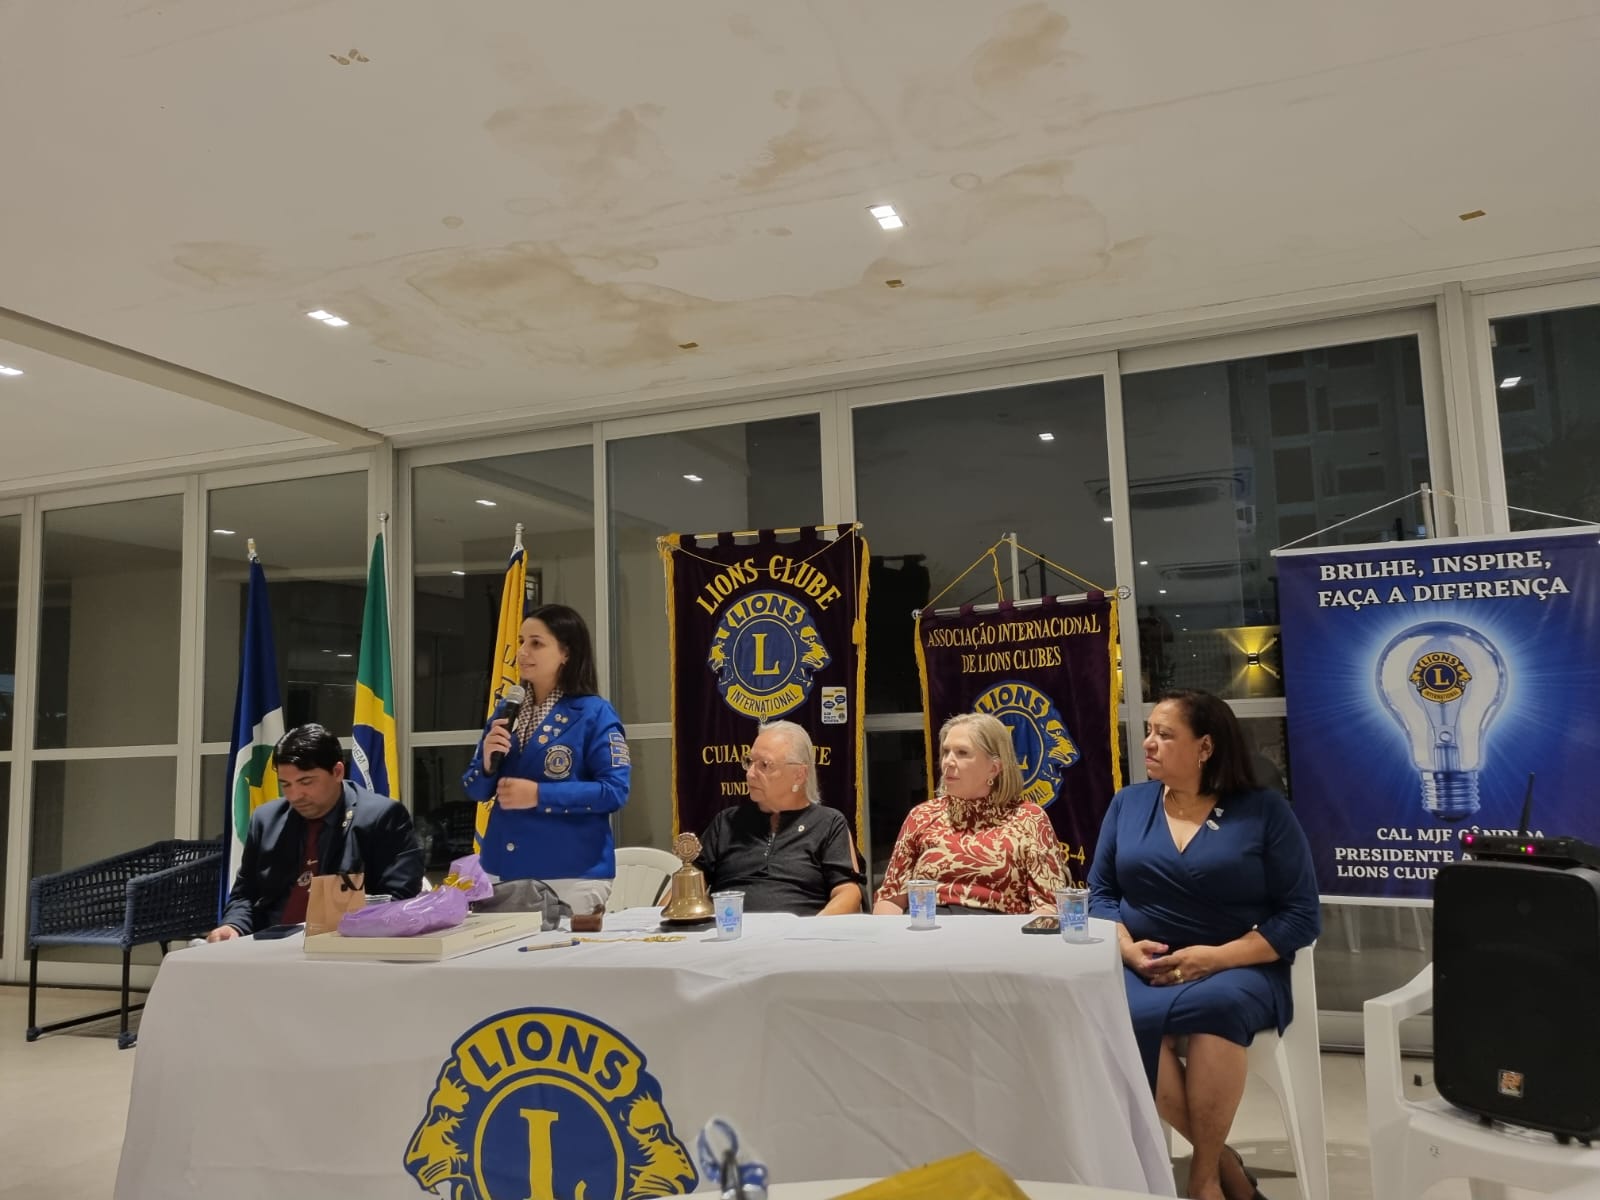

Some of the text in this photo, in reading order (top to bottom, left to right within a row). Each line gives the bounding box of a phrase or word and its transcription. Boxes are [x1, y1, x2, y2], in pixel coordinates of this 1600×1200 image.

[1319, 550, 1552, 582] BRILHE, INSPIRE,
[696, 554, 842, 615] LIONS CLUBE
[1317, 576, 1571, 611] FAÇA A DIFERENÇA
[730, 595, 801, 625] LIONS
[927, 613, 1102, 650] ASSOCIAÇÃO INTERNACIONAL
[751, 633, 780, 676] L
[961, 646, 1062, 674] DE LIONS CLUBES
[1421, 654, 1458, 666] LIONS
[1433, 668, 1451, 686] L
[730, 688, 800, 713] INTERNATIONAL
[979, 687, 1047, 715] LIONS
[702, 744, 752, 765] CUIAB
[720, 782, 750, 796] FUND
[1376, 828, 1413, 841] CAL
[1417, 828, 1453, 844] MJF
[1335, 847, 1455, 863] PRESIDENTE
[1337, 865, 1390, 879] LIONS
[467, 1020, 630, 1091] LIONS
